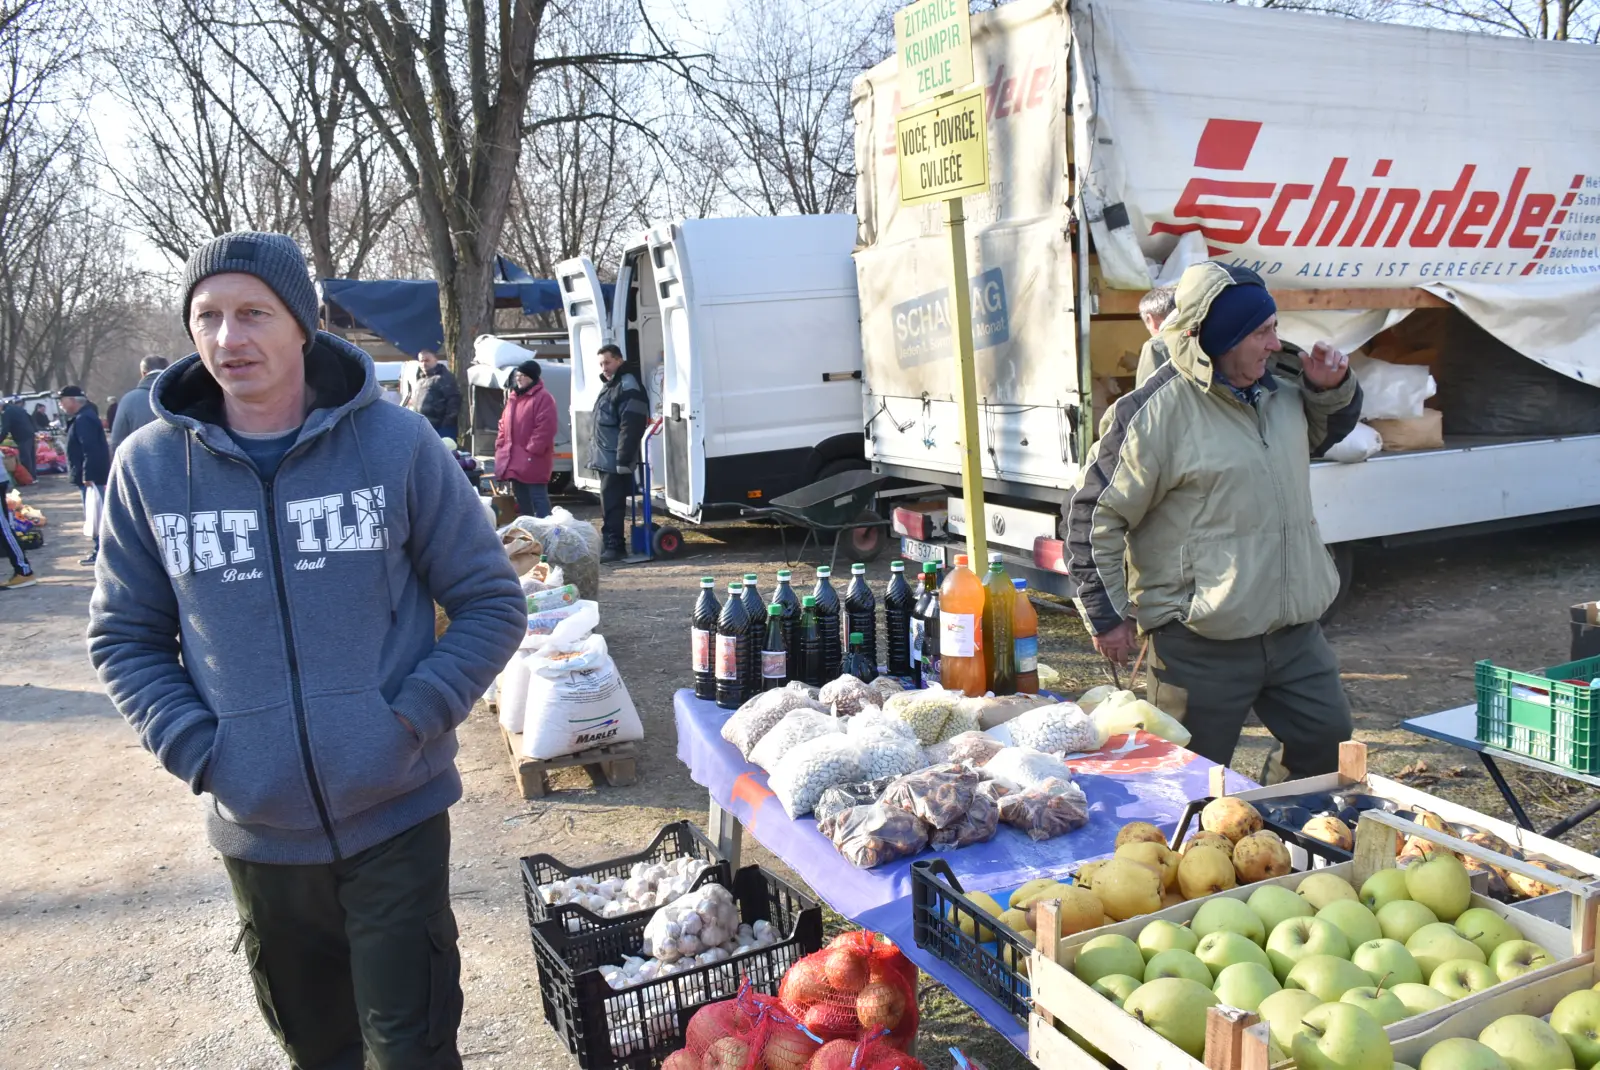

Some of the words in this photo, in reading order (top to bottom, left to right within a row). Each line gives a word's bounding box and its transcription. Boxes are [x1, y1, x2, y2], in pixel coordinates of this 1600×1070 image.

[904, 0, 957, 38] ŽITARICE
[905, 23, 961, 69] KRUMPIR
[917, 59, 952, 93] ZELJE
[901, 122, 931, 157] VOĆE,
[933, 107, 980, 149] POVRĆE,
[920, 150, 963, 189] CVIJEĆE
[1148, 156, 1557, 249] Schindele
[1559, 230, 1597, 242] Küchen
[1296, 261, 1362, 277] ALLES
[1375, 262, 1410, 277] IST
[1419, 261, 1519, 277] GEREGELT
[153, 509, 259, 578] BAT
[286, 485, 389, 552] TLE
